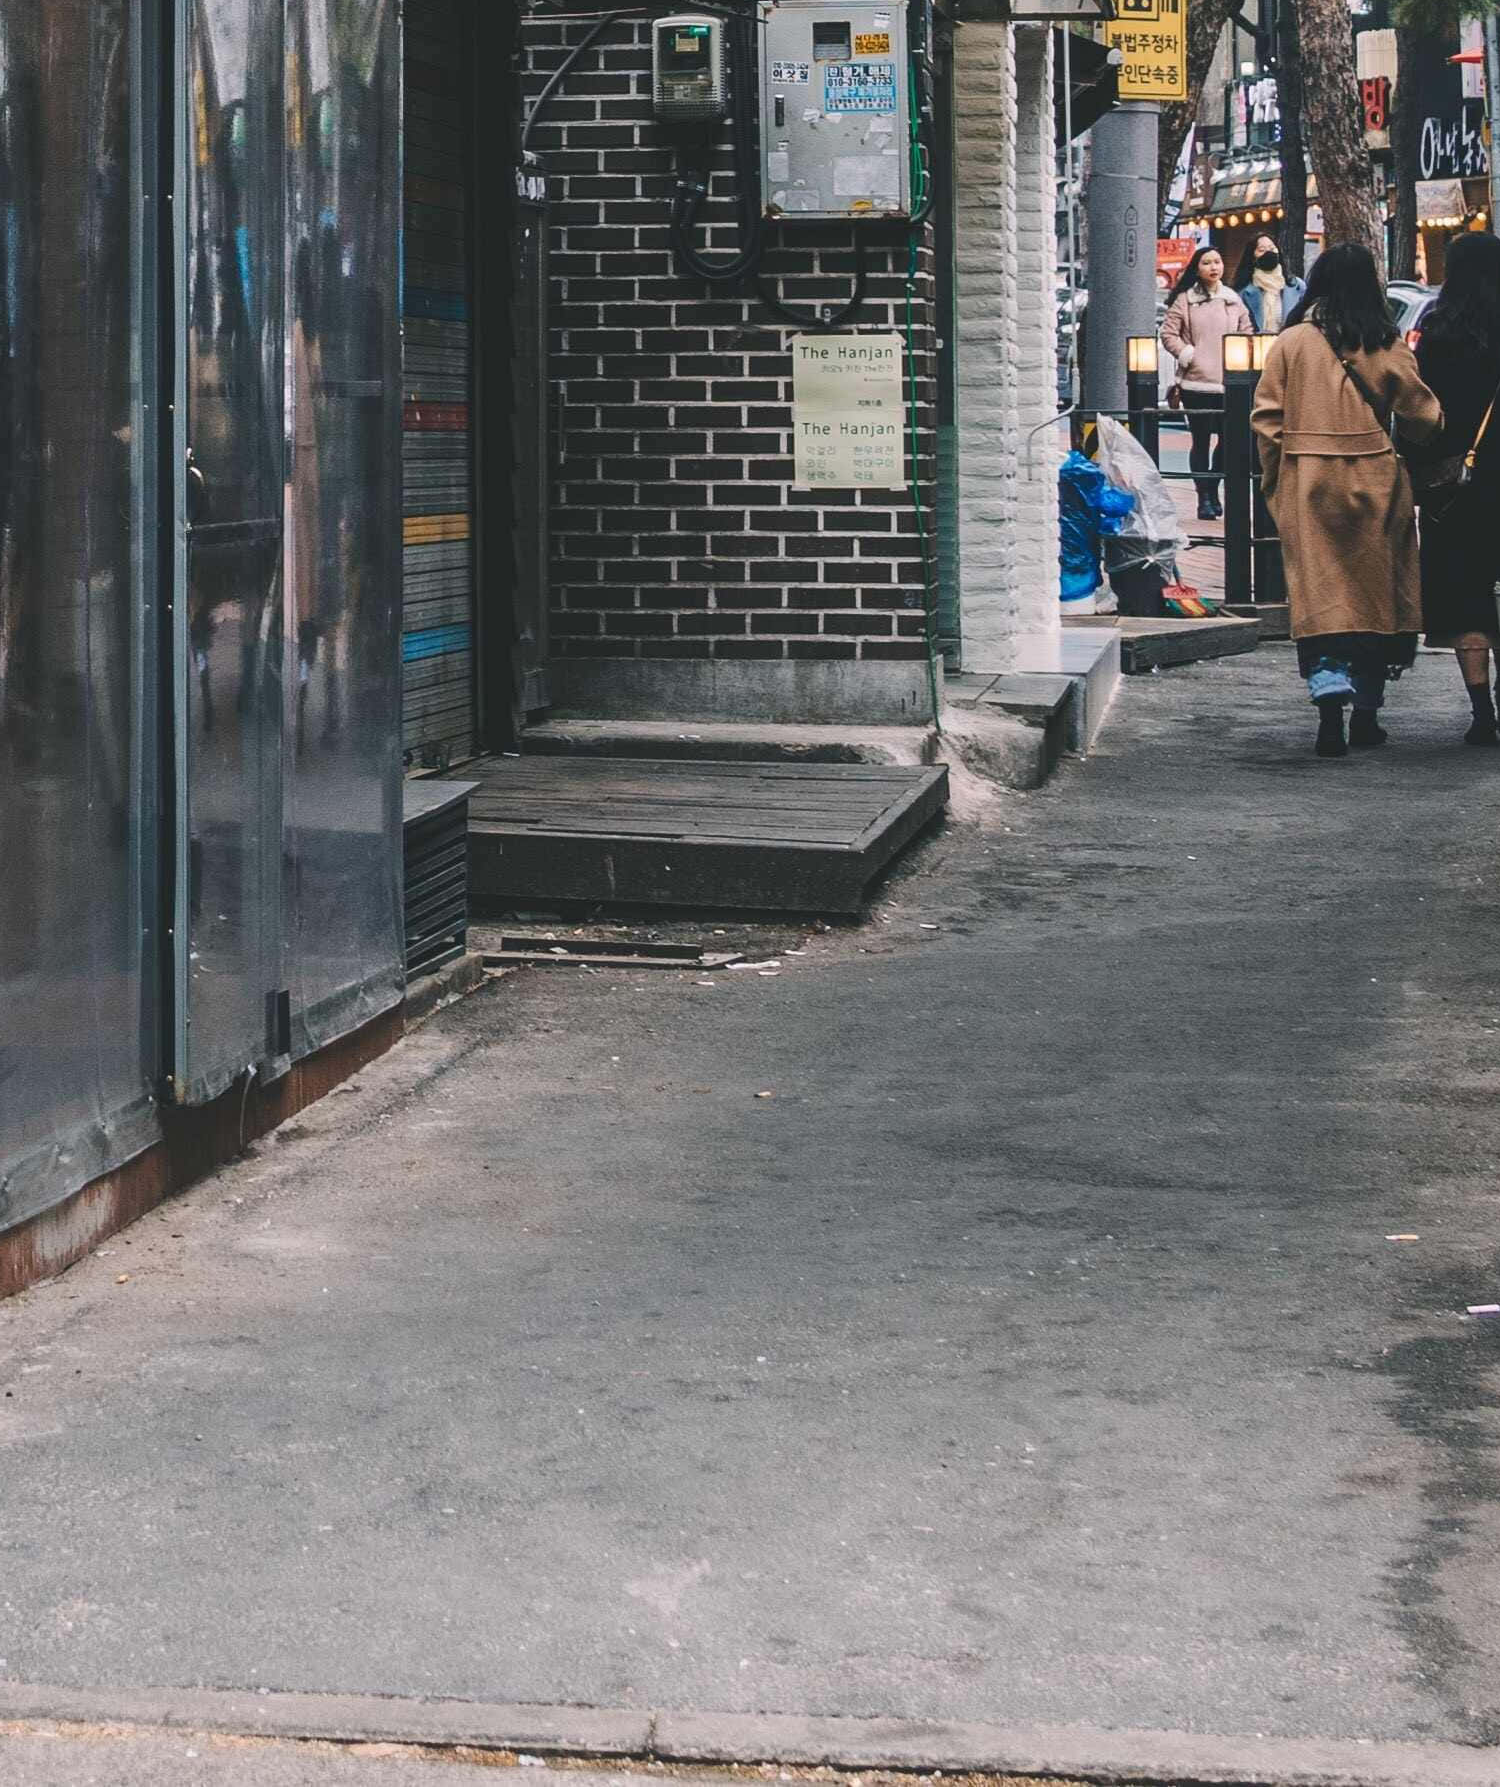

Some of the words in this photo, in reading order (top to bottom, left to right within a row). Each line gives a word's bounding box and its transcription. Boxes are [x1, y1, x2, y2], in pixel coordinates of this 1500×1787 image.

[800, 346, 829, 359] The
[838, 346, 894, 361] Hanjan
[802, 422, 832, 435] The
[839, 422, 895, 437] Hanjan
